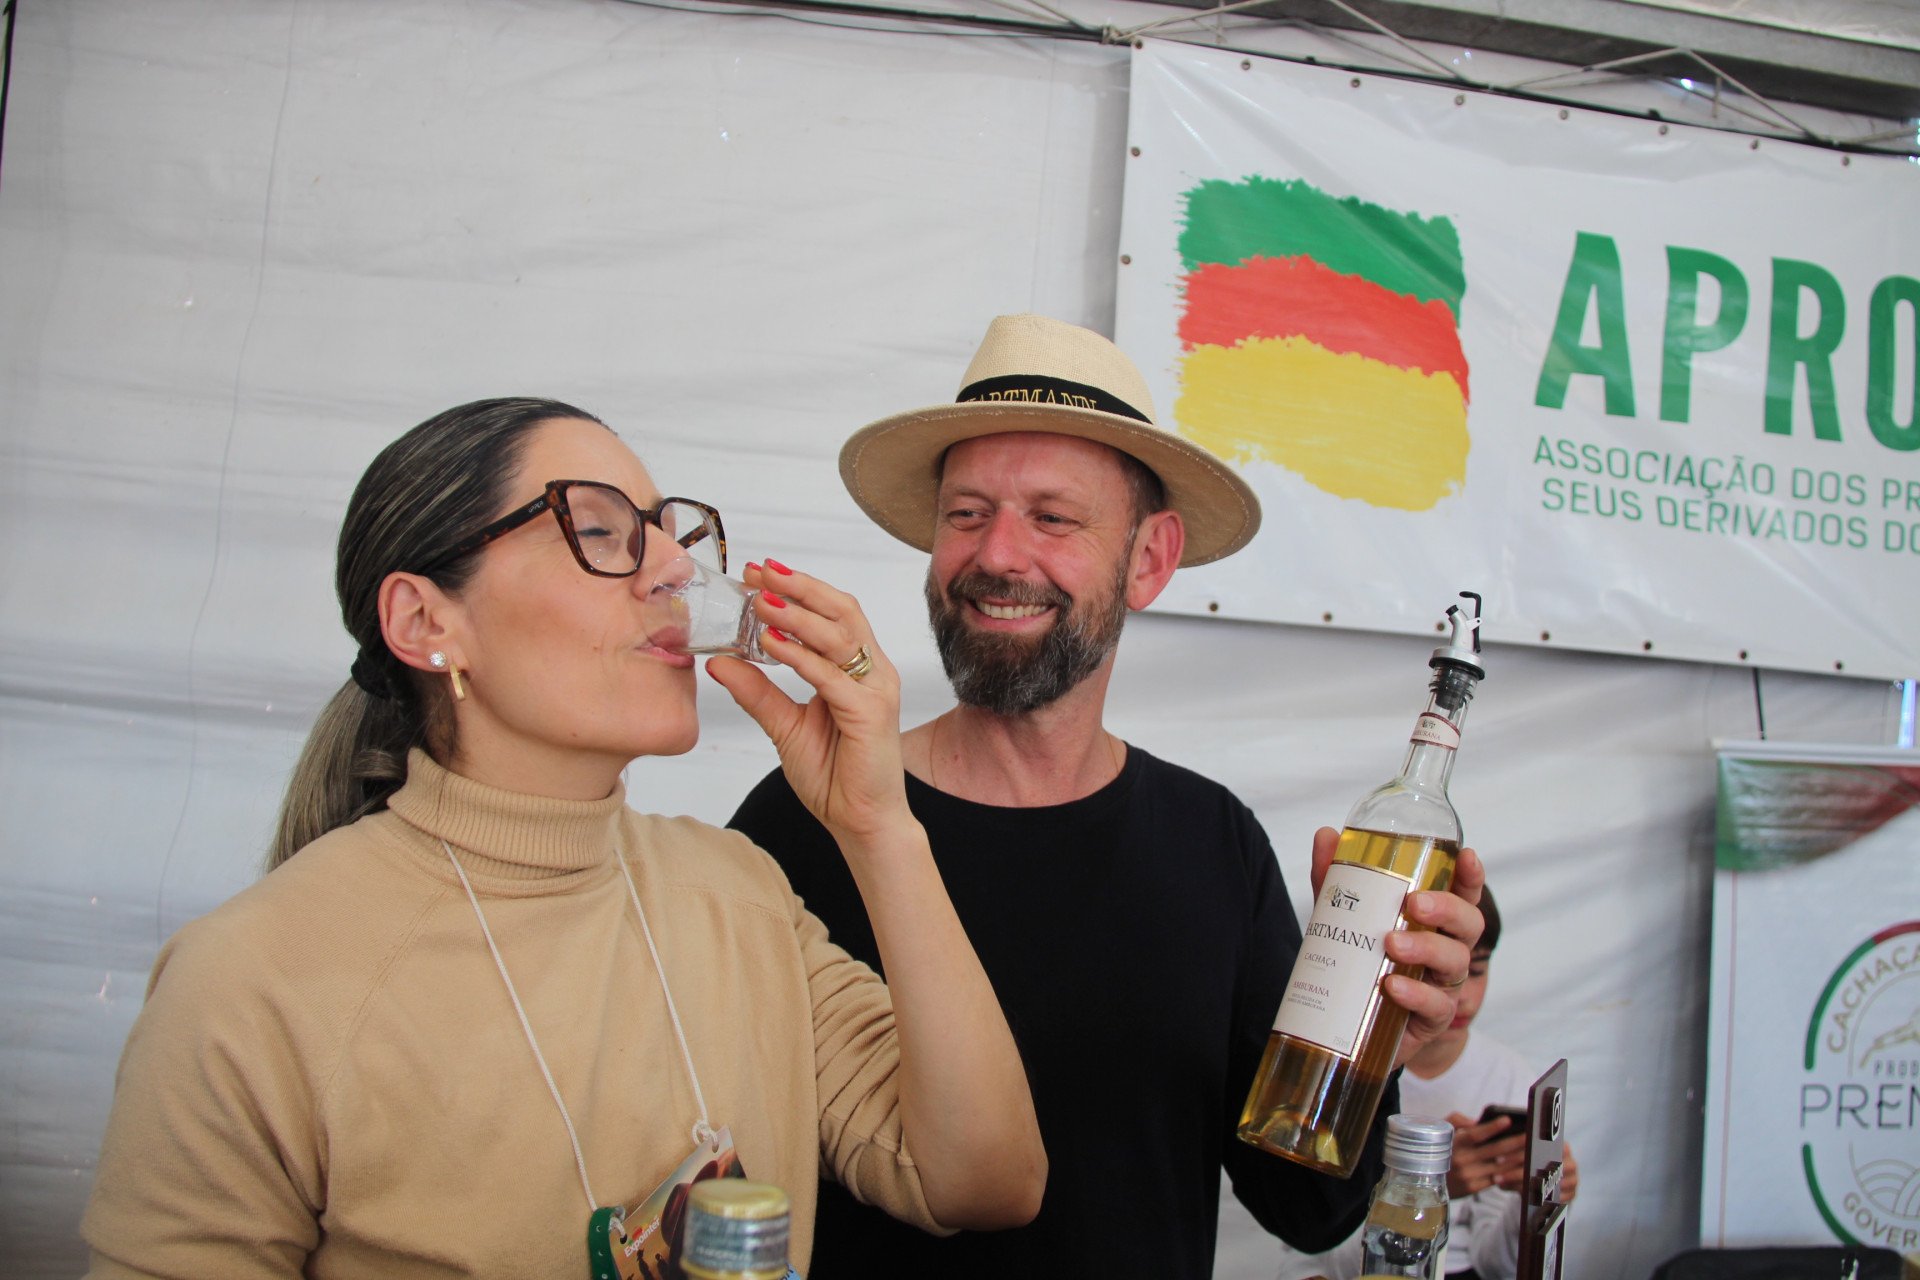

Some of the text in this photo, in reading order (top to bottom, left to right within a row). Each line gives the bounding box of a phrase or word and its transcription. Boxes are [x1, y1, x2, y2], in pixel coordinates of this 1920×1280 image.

[1534, 230, 1920, 452] APRO
[1533, 434, 1920, 512] ASSOCIAÇÃO DOS PR
[1542, 476, 1642, 522] SEUS
[1656, 494, 1869, 549] DERIVADOS
[1304, 952, 1336, 967] CACHAÇA
[1306, 922, 1376, 951] ARTMANN
[1800, 1083, 1920, 1129] PRE
[1843, 1192, 1918, 1248] GOVER
